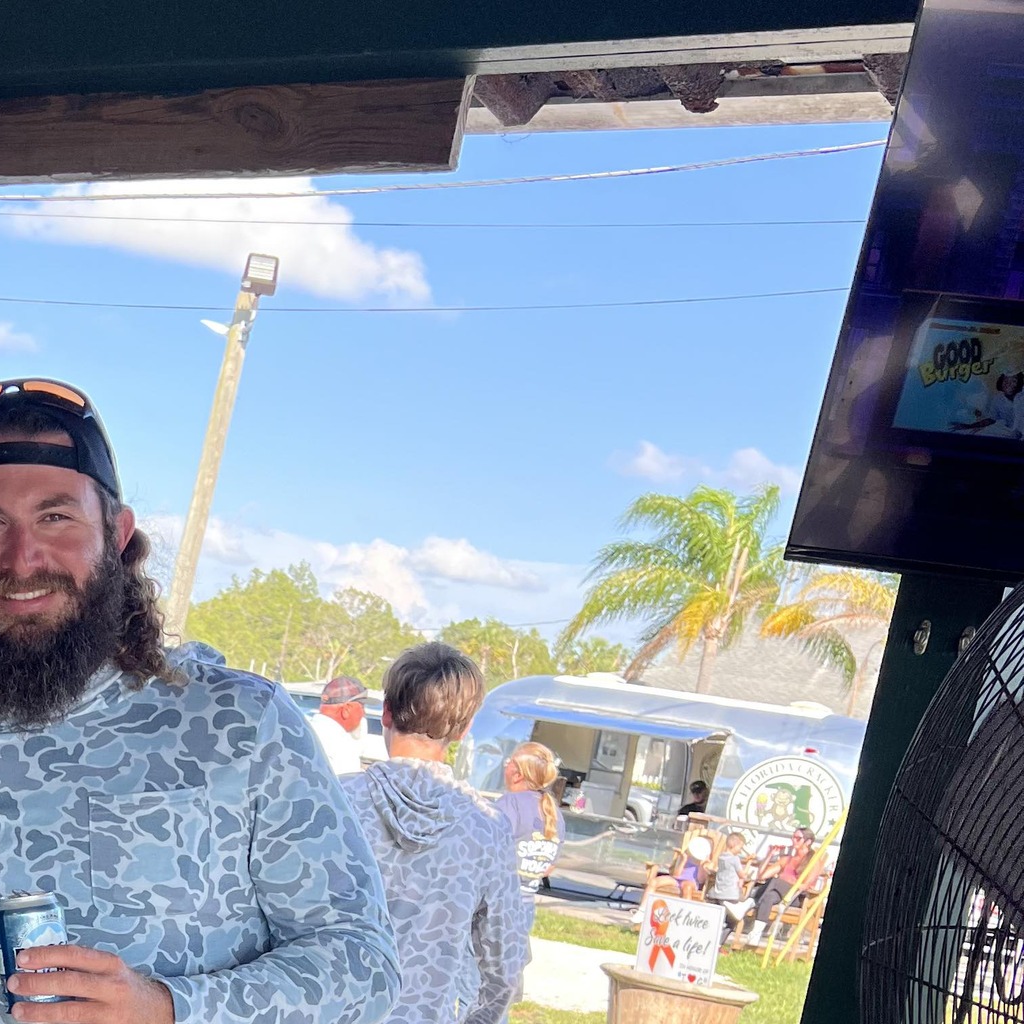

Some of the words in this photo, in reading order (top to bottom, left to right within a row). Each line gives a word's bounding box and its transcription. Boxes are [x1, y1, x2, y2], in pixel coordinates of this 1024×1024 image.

[933, 338, 982, 369] GOOD
[739, 763, 793, 797] FLORIDA
[798, 766, 839, 812] CRACKER
